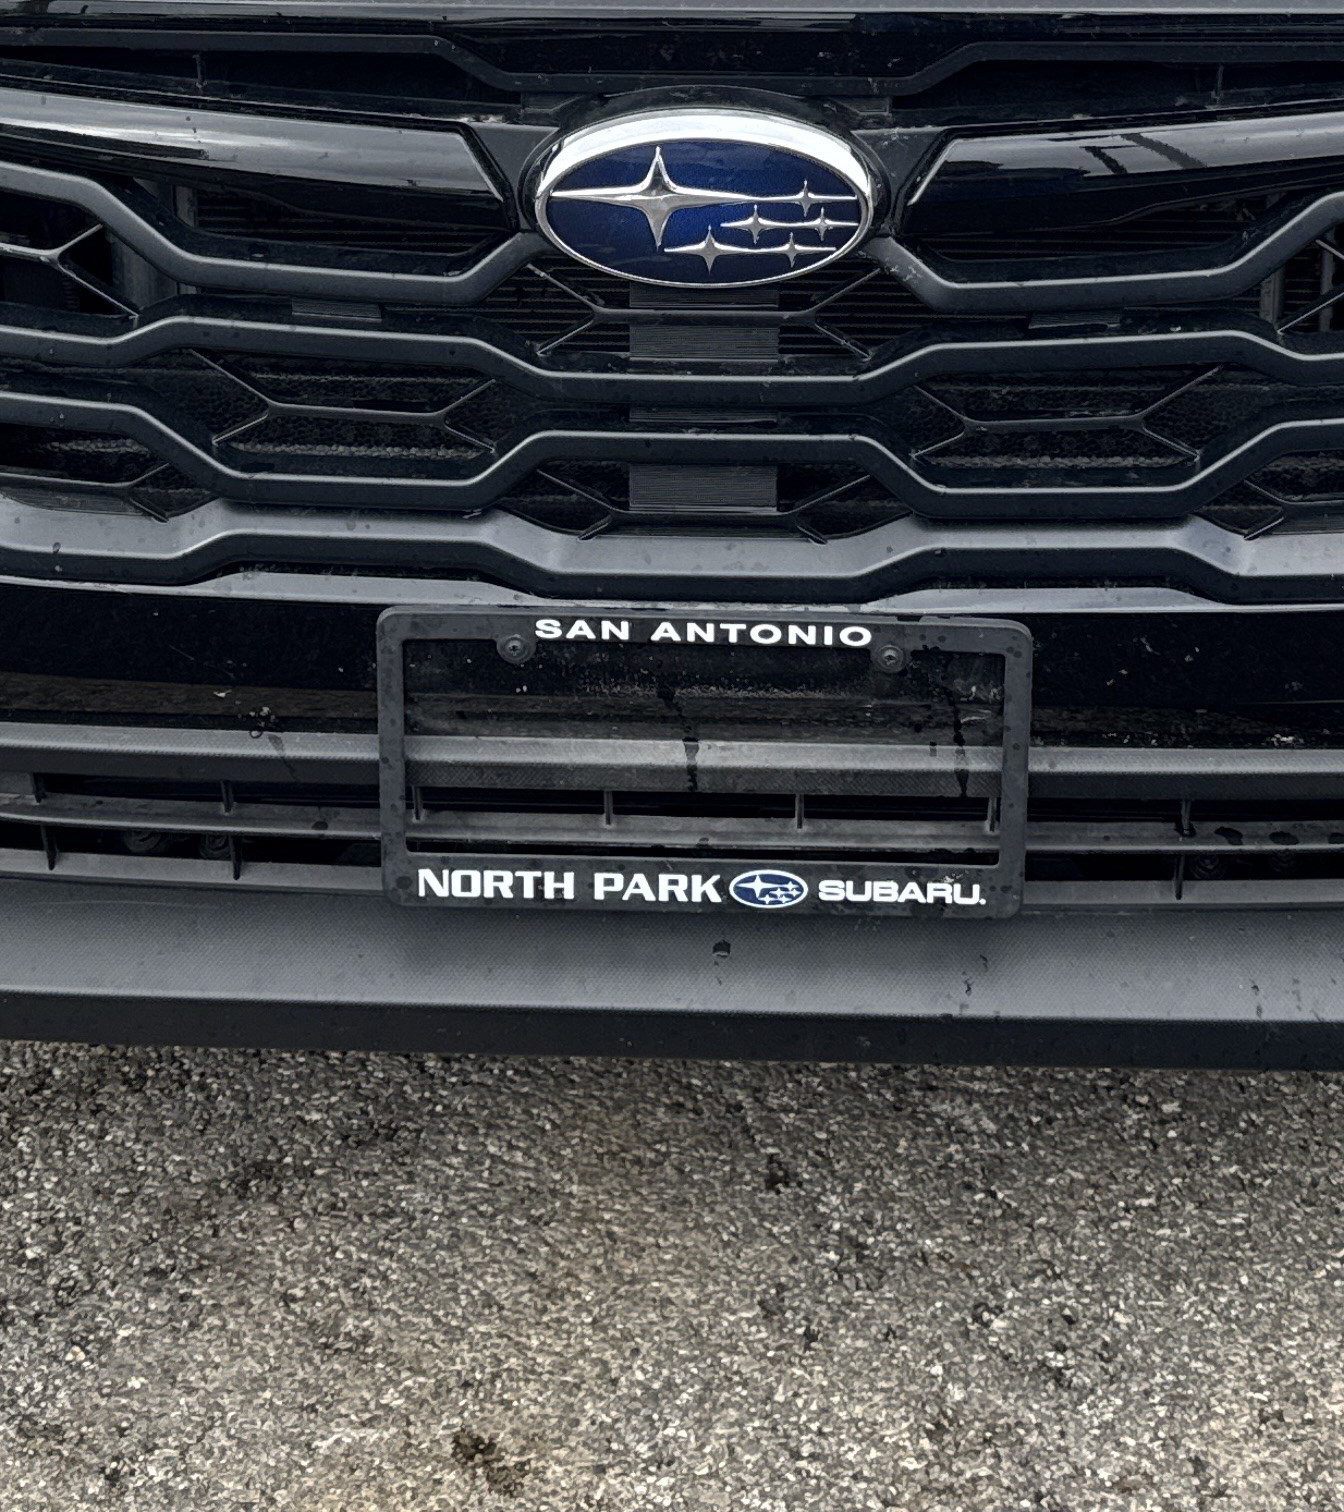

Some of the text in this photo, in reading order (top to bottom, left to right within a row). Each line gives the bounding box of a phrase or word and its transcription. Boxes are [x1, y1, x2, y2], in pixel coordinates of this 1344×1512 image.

[535, 618, 873, 647] SAN ANTONIO
[417, 868, 576, 900] NORTH
[593, 872, 722, 904] PARK
